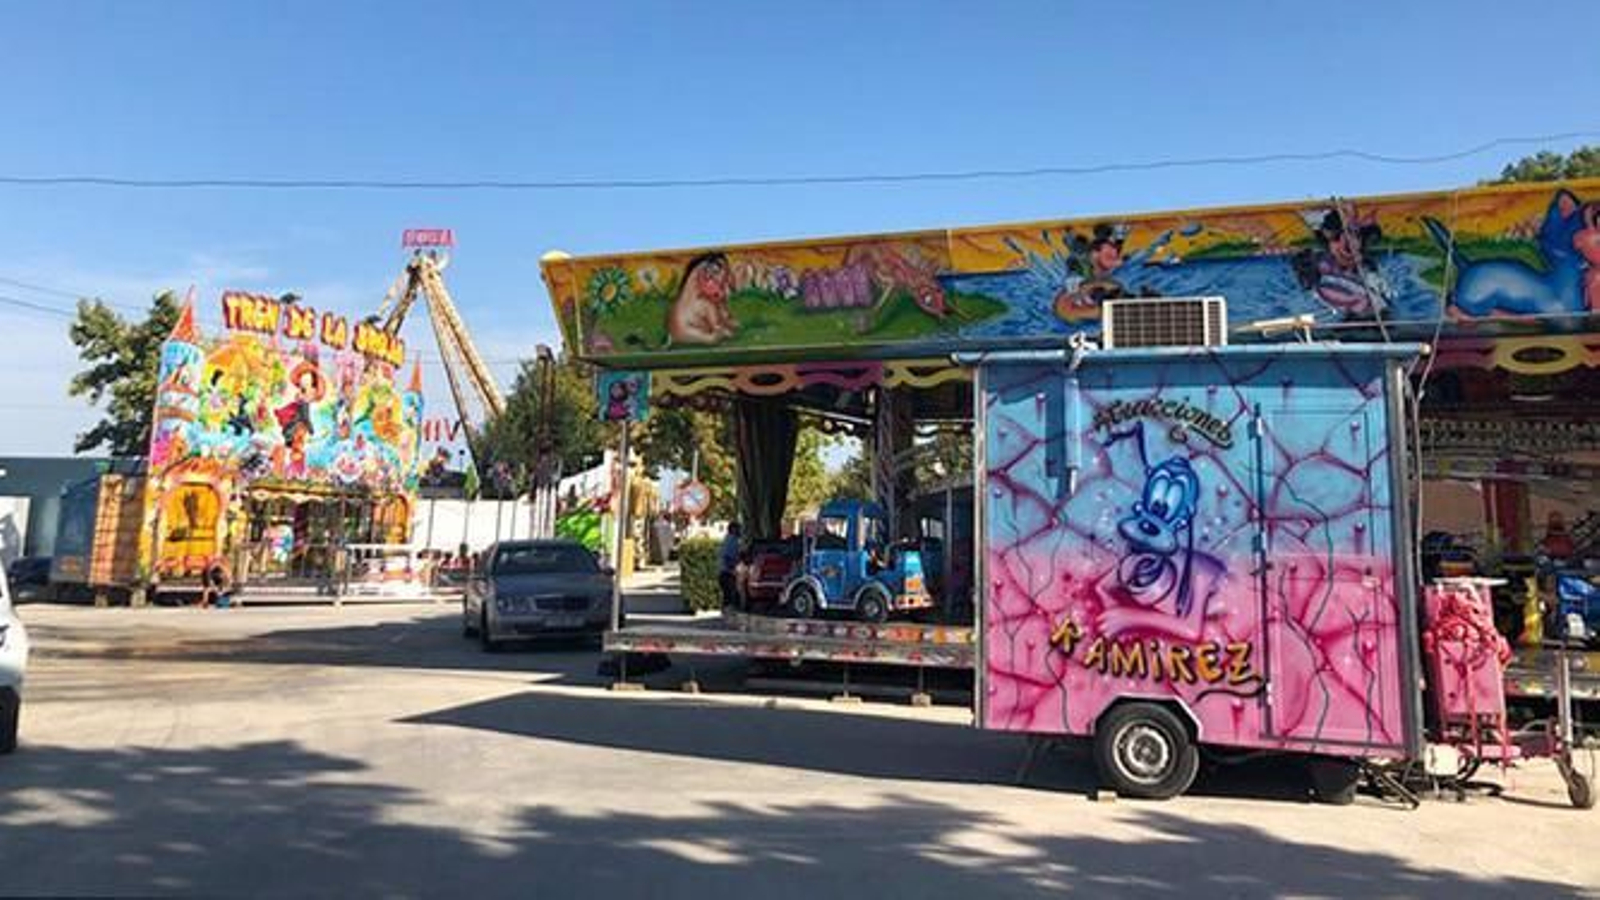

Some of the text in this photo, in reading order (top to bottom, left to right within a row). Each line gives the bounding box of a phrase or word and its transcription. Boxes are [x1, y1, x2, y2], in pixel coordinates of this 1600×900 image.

[223, 291, 280, 335] TREN
[284, 305, 315, 340] DE
[321, 312, 347, 350] LA
